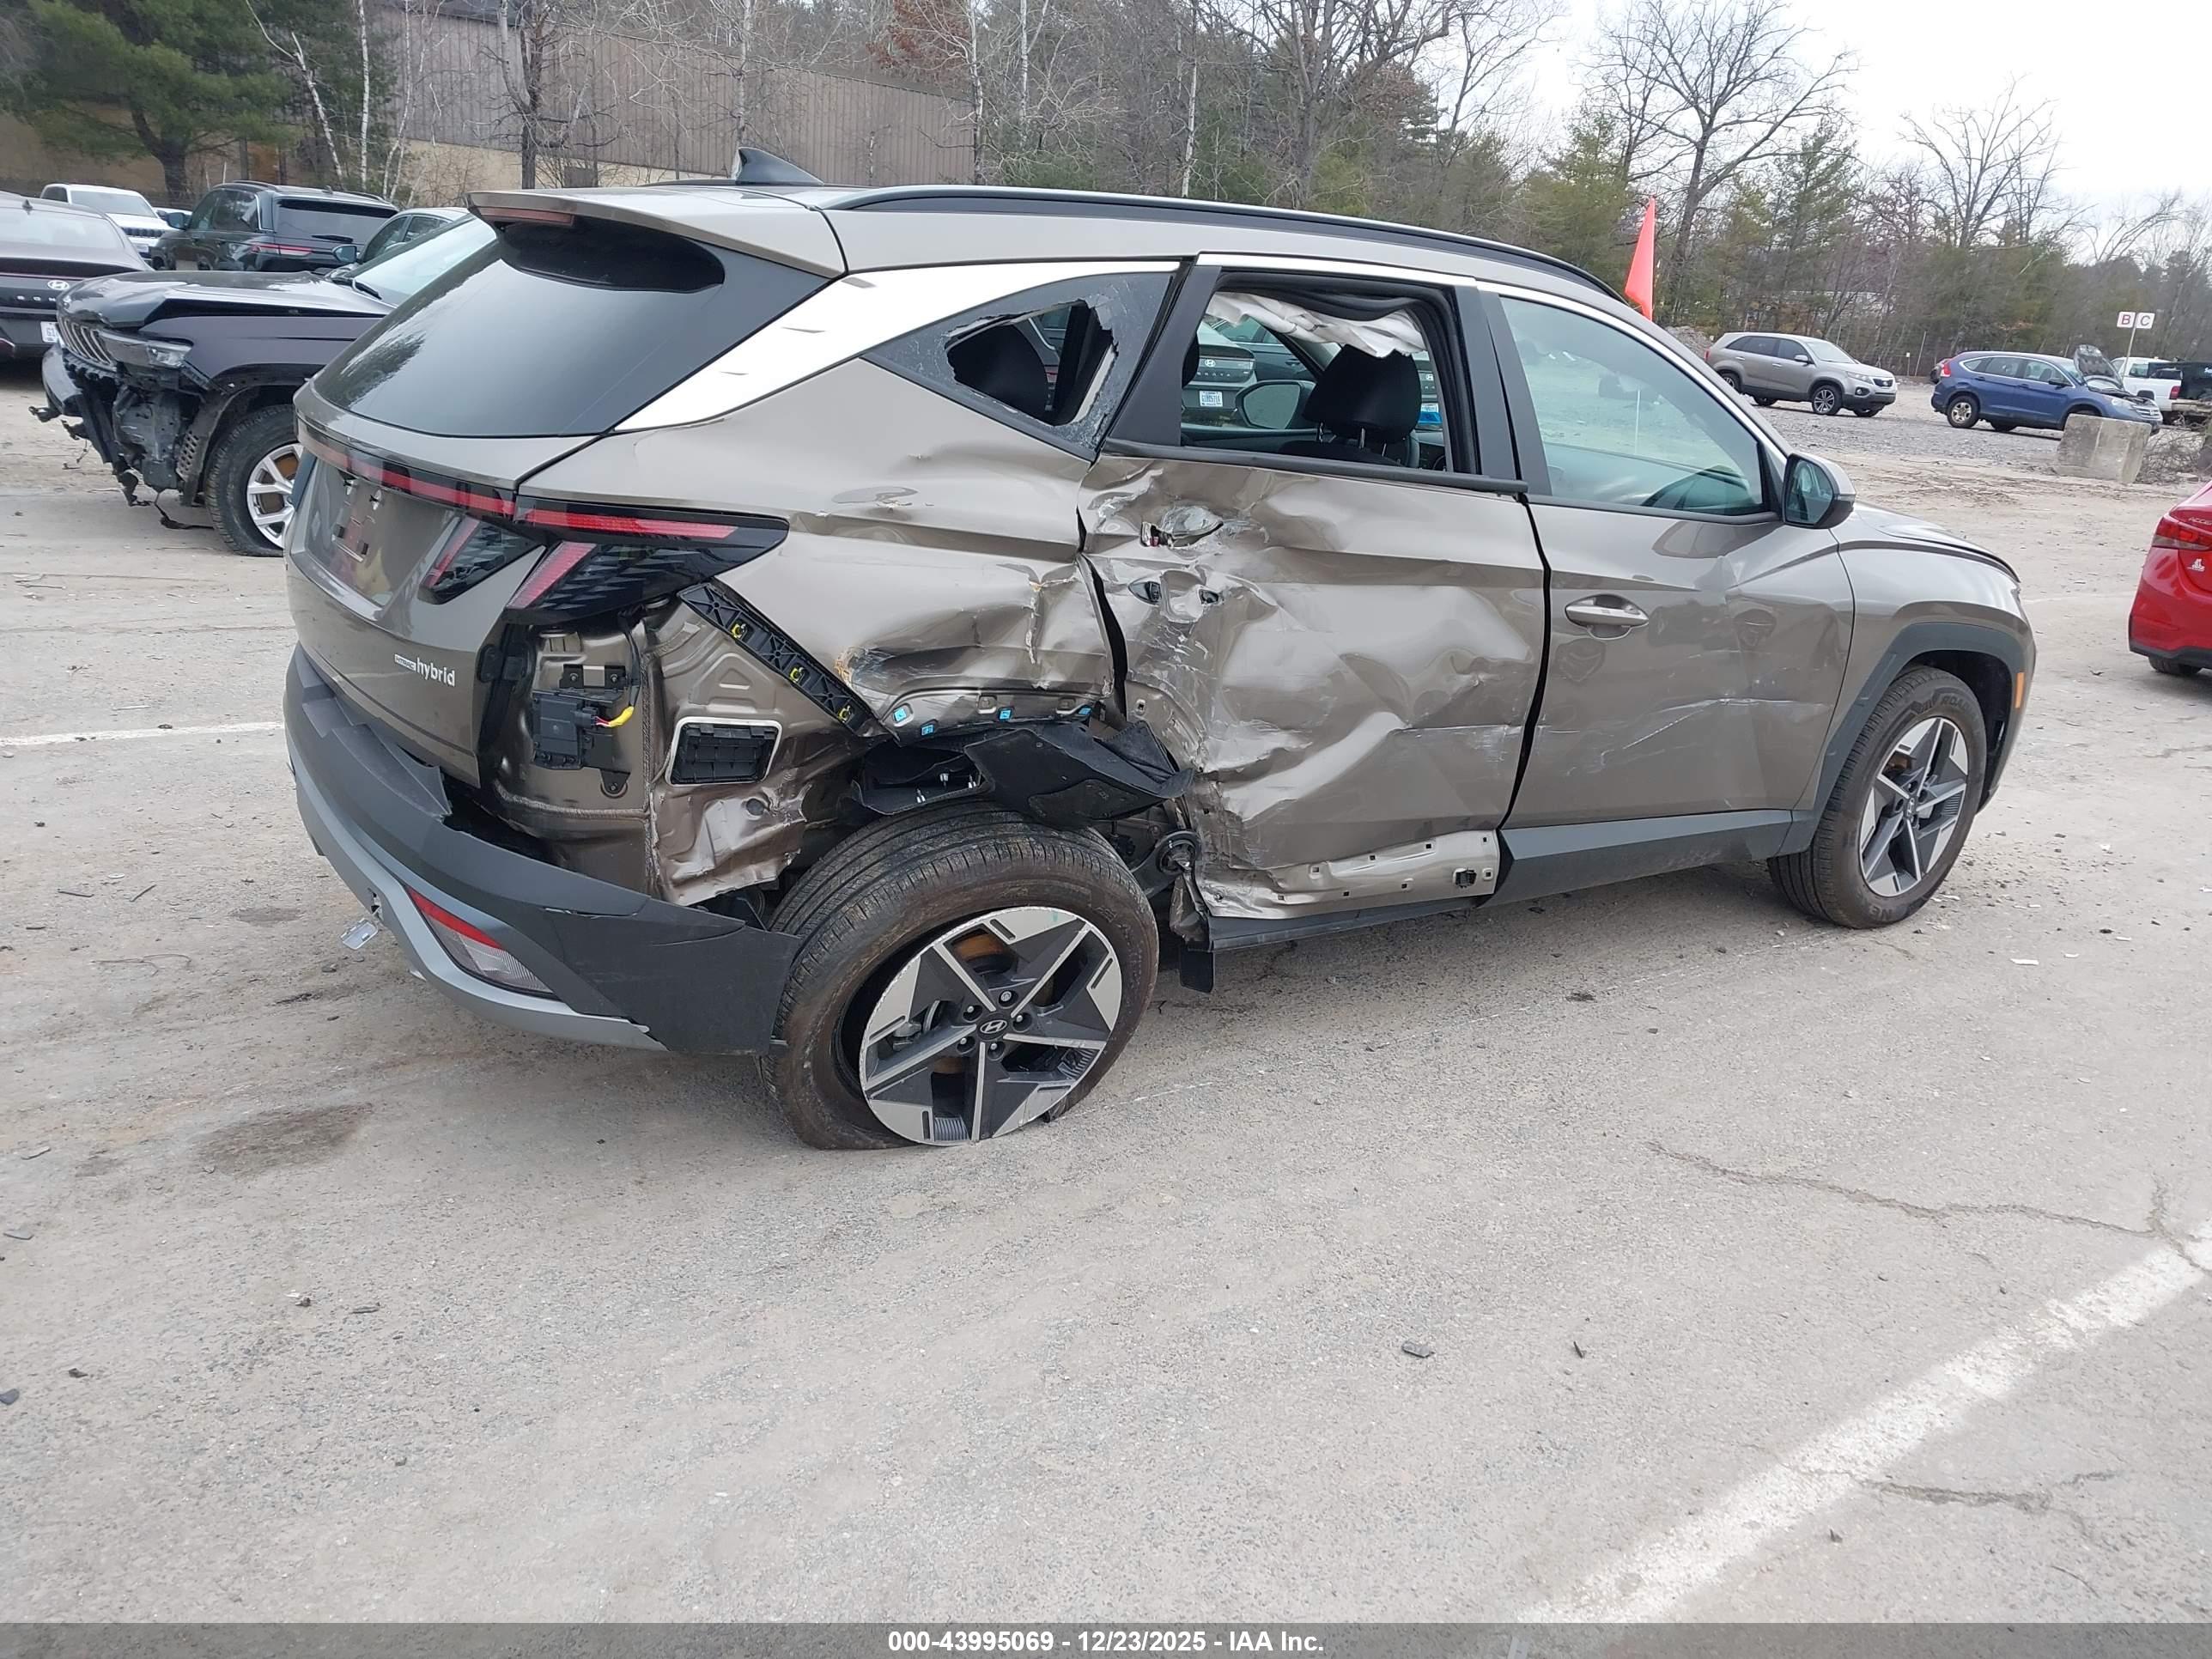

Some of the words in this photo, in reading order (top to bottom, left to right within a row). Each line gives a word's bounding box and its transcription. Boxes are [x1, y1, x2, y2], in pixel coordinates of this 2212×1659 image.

[2121, 314, 2130, 325] B
[2141, 315, 2150, 326] C
[416, 656, 455, 687] hybrid
